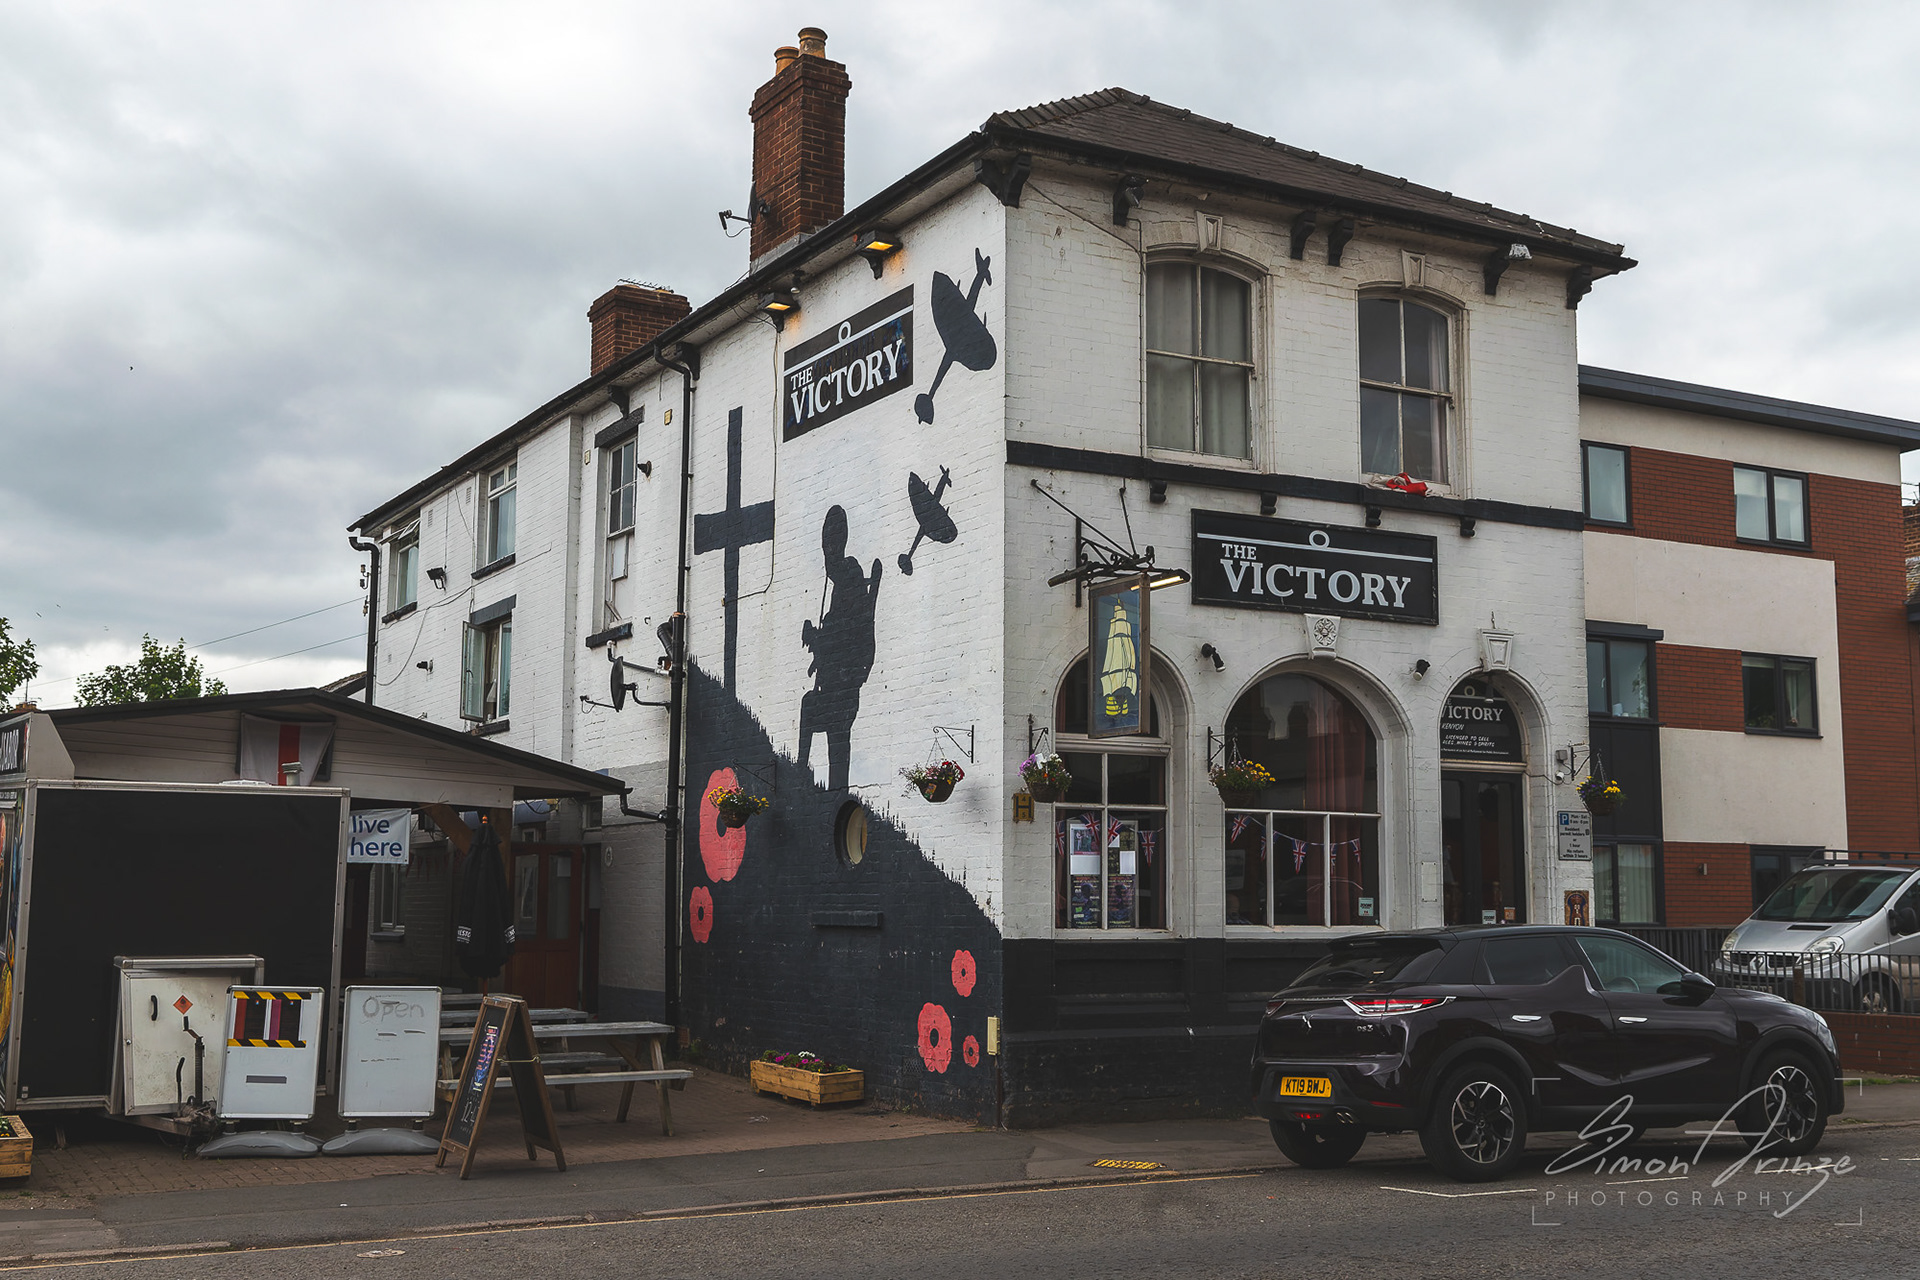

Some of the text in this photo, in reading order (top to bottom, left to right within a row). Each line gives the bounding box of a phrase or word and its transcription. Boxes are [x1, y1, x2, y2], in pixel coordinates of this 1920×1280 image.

[790, 338, 903, 424] VICTORY
[791, 366, 813, 391] THE
[1221, 543, 1257, 561] THE
[1219, 558, 1412, 609] VICTORY
[1016, 795, 1032, 818] H
[352, 815, 390, 834] live
[351, 837, 403, 857] here
[363, 996, 425, 1022] Open
[1285, 1078, 1306, 1093] KT19
